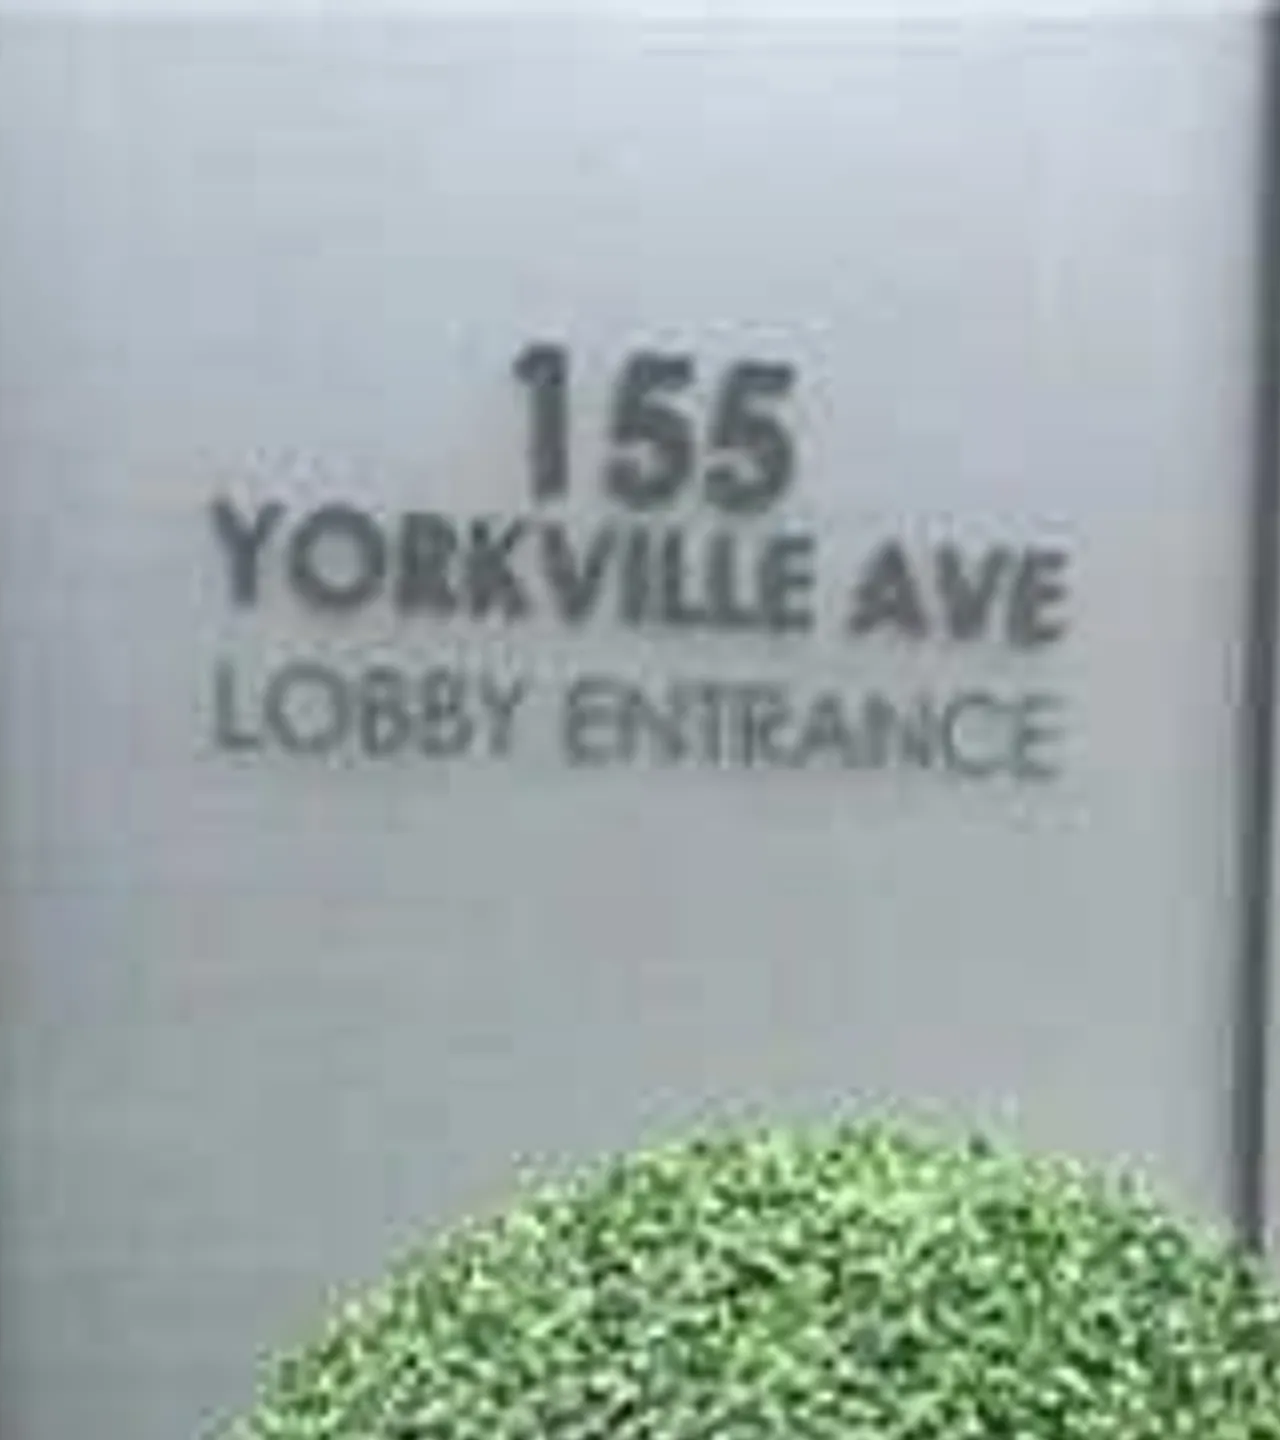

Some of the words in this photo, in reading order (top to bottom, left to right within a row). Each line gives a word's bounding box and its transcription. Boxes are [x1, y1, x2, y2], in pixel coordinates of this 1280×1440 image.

[512, 343, 796, 512] 155
[210, 499, 816, 632] YORKVILLE
[850, 540, 1072, 645] AVE
[214, 660, 526, 760] LOBBY
[563, 676, 1067, 777] ENTRANCE
